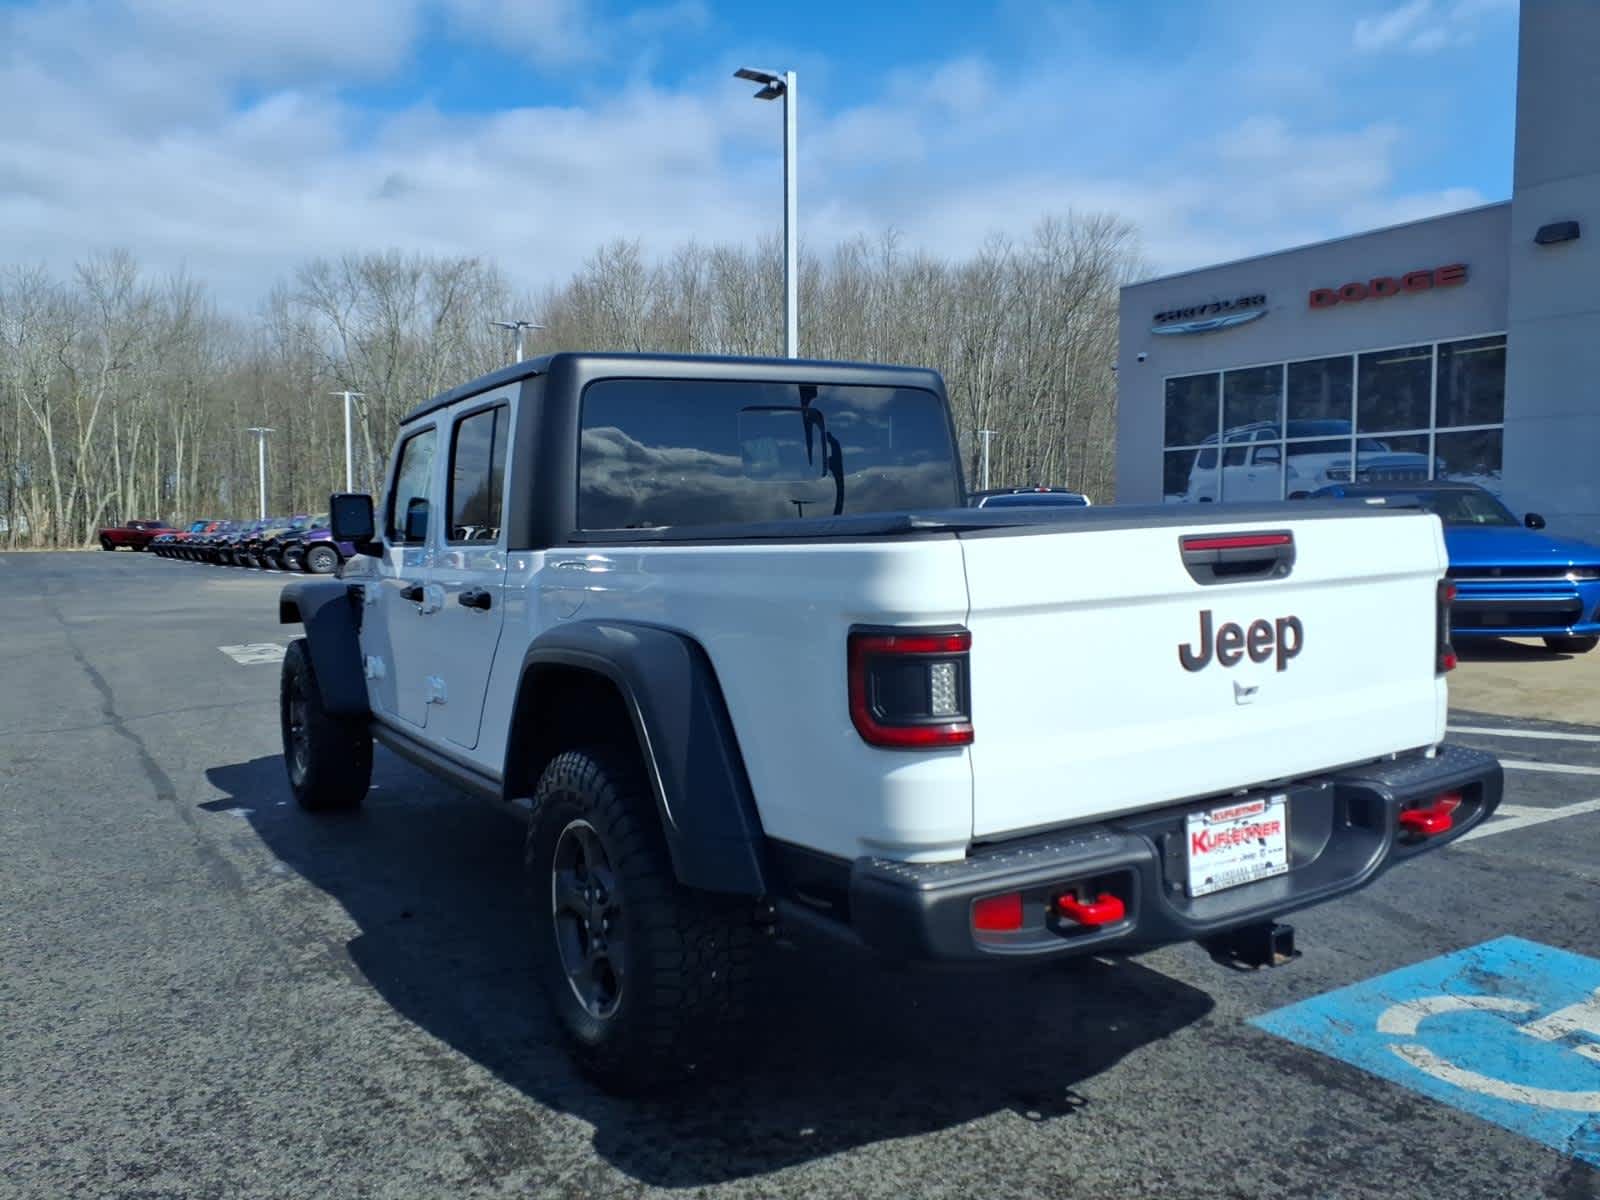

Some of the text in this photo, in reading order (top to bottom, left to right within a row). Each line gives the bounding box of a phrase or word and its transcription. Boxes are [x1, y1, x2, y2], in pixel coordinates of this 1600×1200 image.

[1153, 293, 1266, 322] CHRYSLER
[1309, 263, 1469, 309] DODGE
[1178, 609, 1304, 673] Jeep
